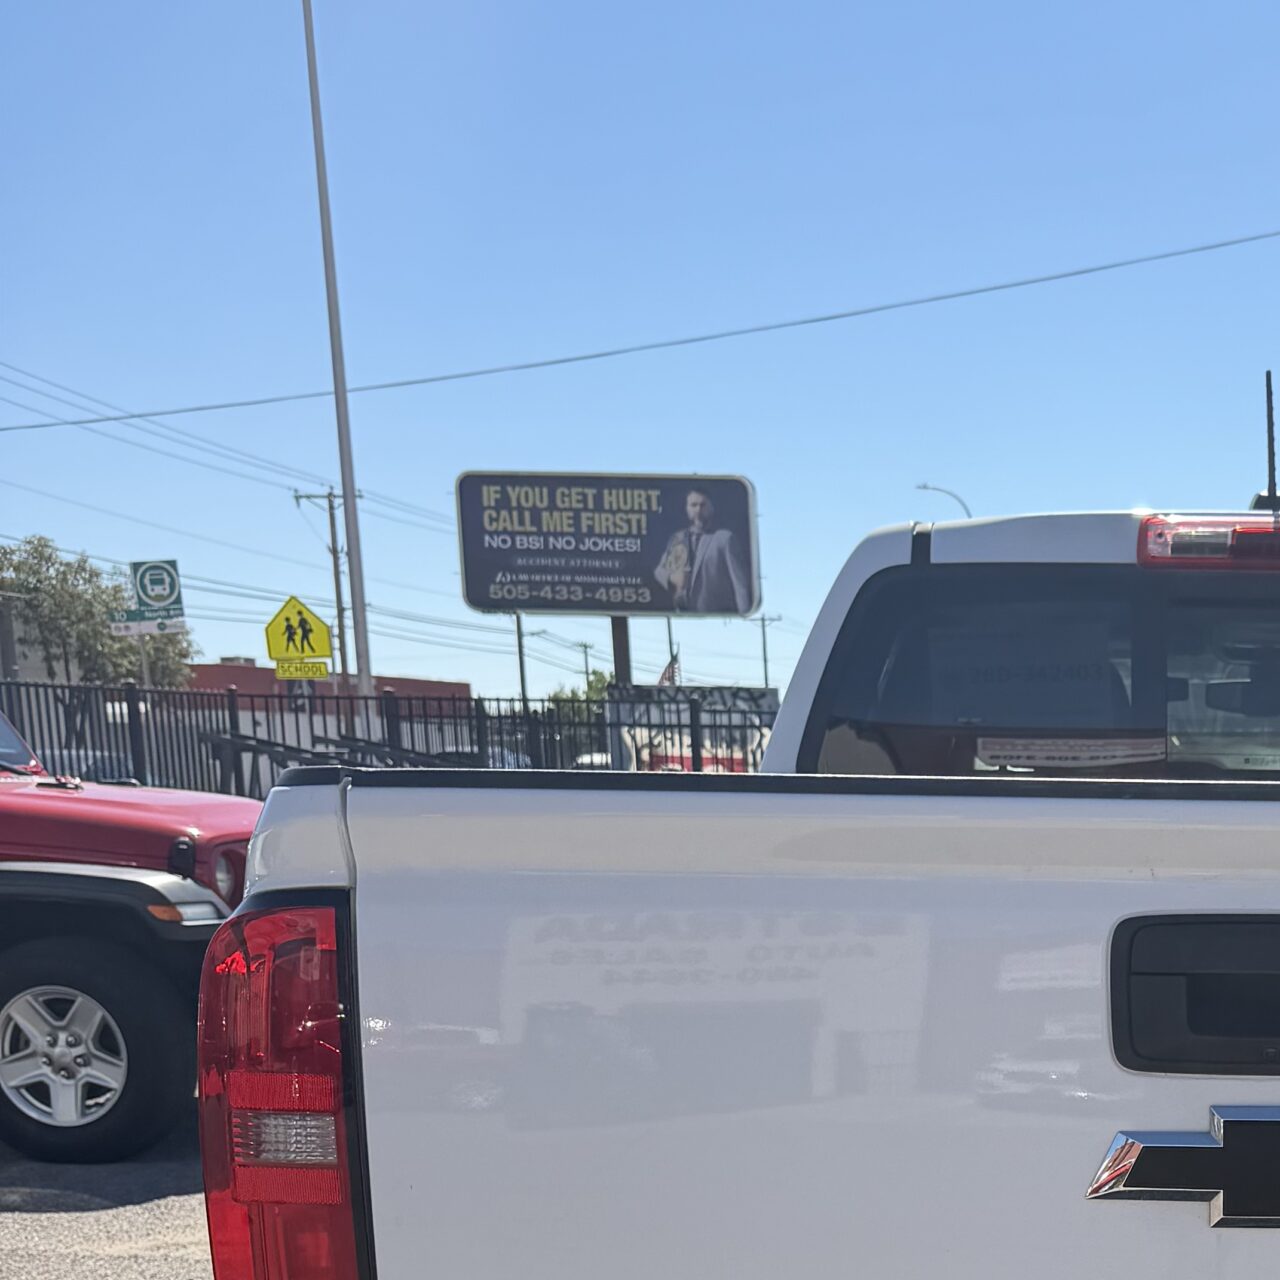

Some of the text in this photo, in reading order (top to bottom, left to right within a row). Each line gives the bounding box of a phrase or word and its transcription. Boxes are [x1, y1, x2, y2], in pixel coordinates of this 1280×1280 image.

[482, 485, 663, 513] IF YOU GET HURT,
[483, 509, 647, 535] CALL ME FIRST!
[484, 534, 641, 552] NO BS! NO JOKES!
[517, 557, 620, 569] ACCIDENT ATTORNEY
[489, 583, 652, 603] 505-433-4953
[280, 663, 325, 676] SCHOOL
